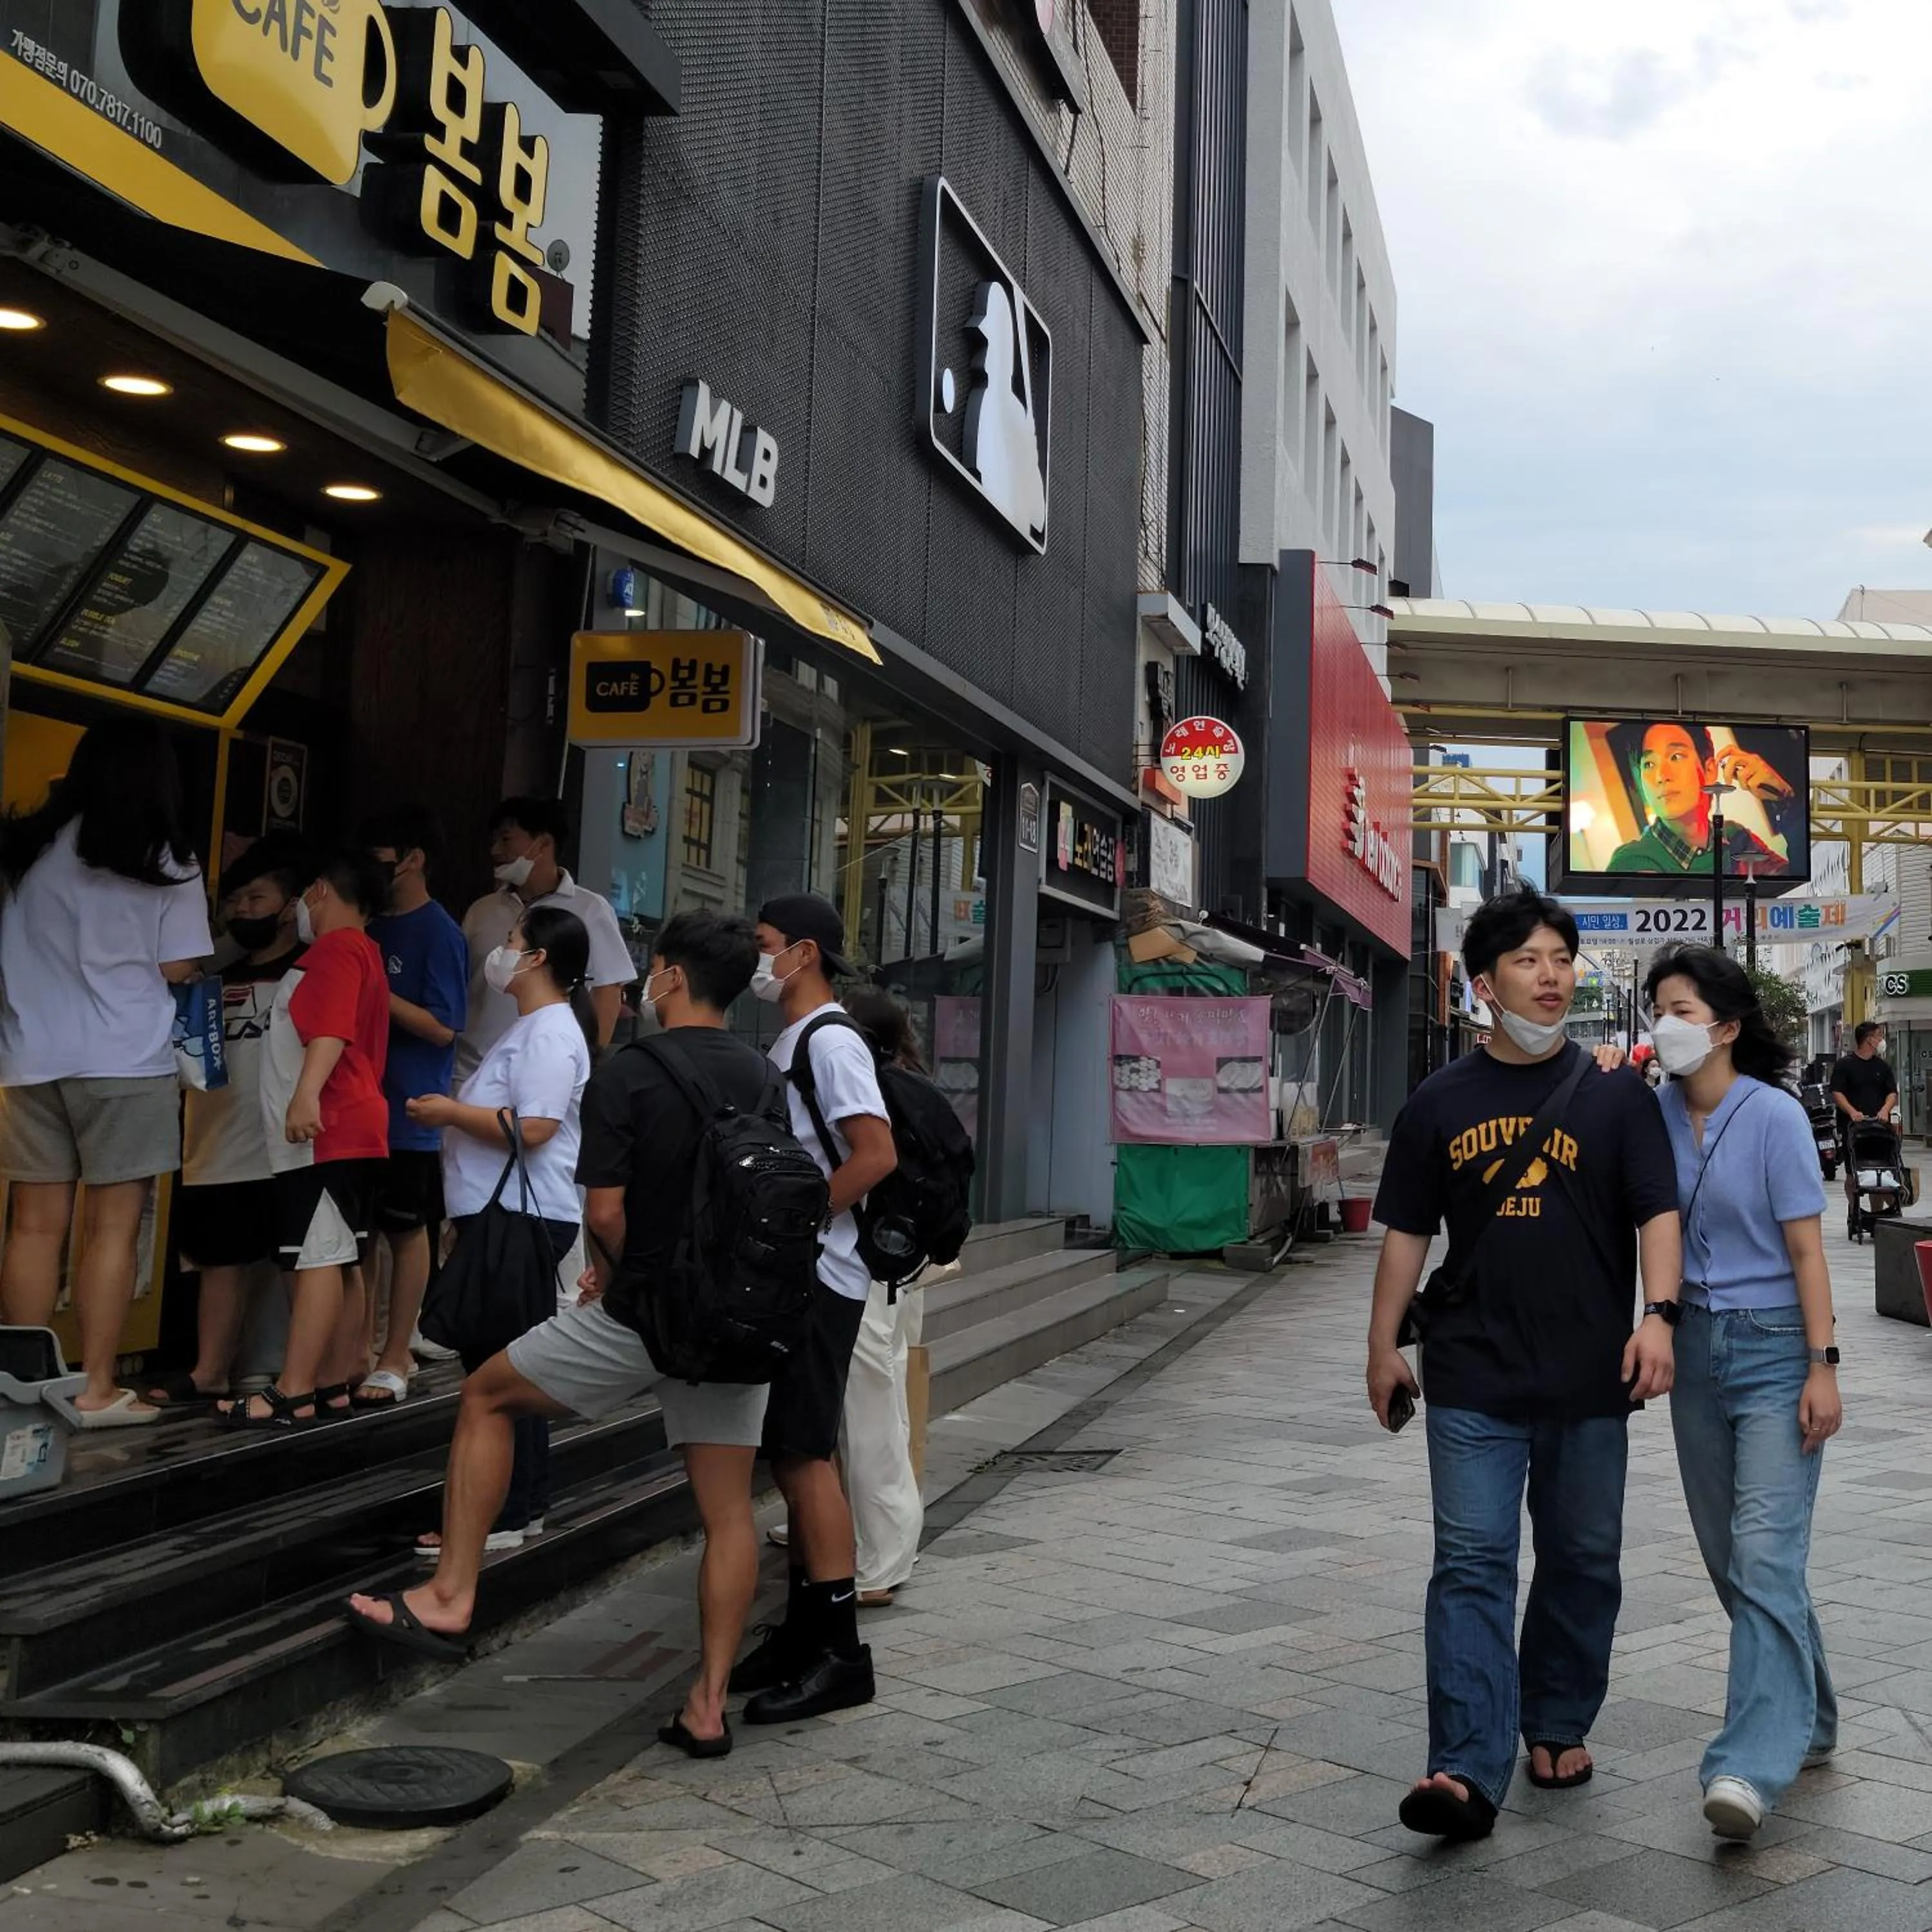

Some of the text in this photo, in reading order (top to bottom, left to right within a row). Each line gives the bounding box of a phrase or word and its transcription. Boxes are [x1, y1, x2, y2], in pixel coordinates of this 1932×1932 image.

[10, 29, 162, 149] 가맹점문의 070.7817.1100
[420, 6, 549, 337] 봄봄
[690, 379, 778, 508] MLB
[669, 658, 731, 714] 봄봄
[1180, 745, 1220, 760] 24시
[1582, 914, 1600, 929] 시민
[1635, 908, 1707, 933] 2022
[206, 998, 223, 1071] ARTBOX
[1449, 1116, 1578, 1171] SOUVIR
